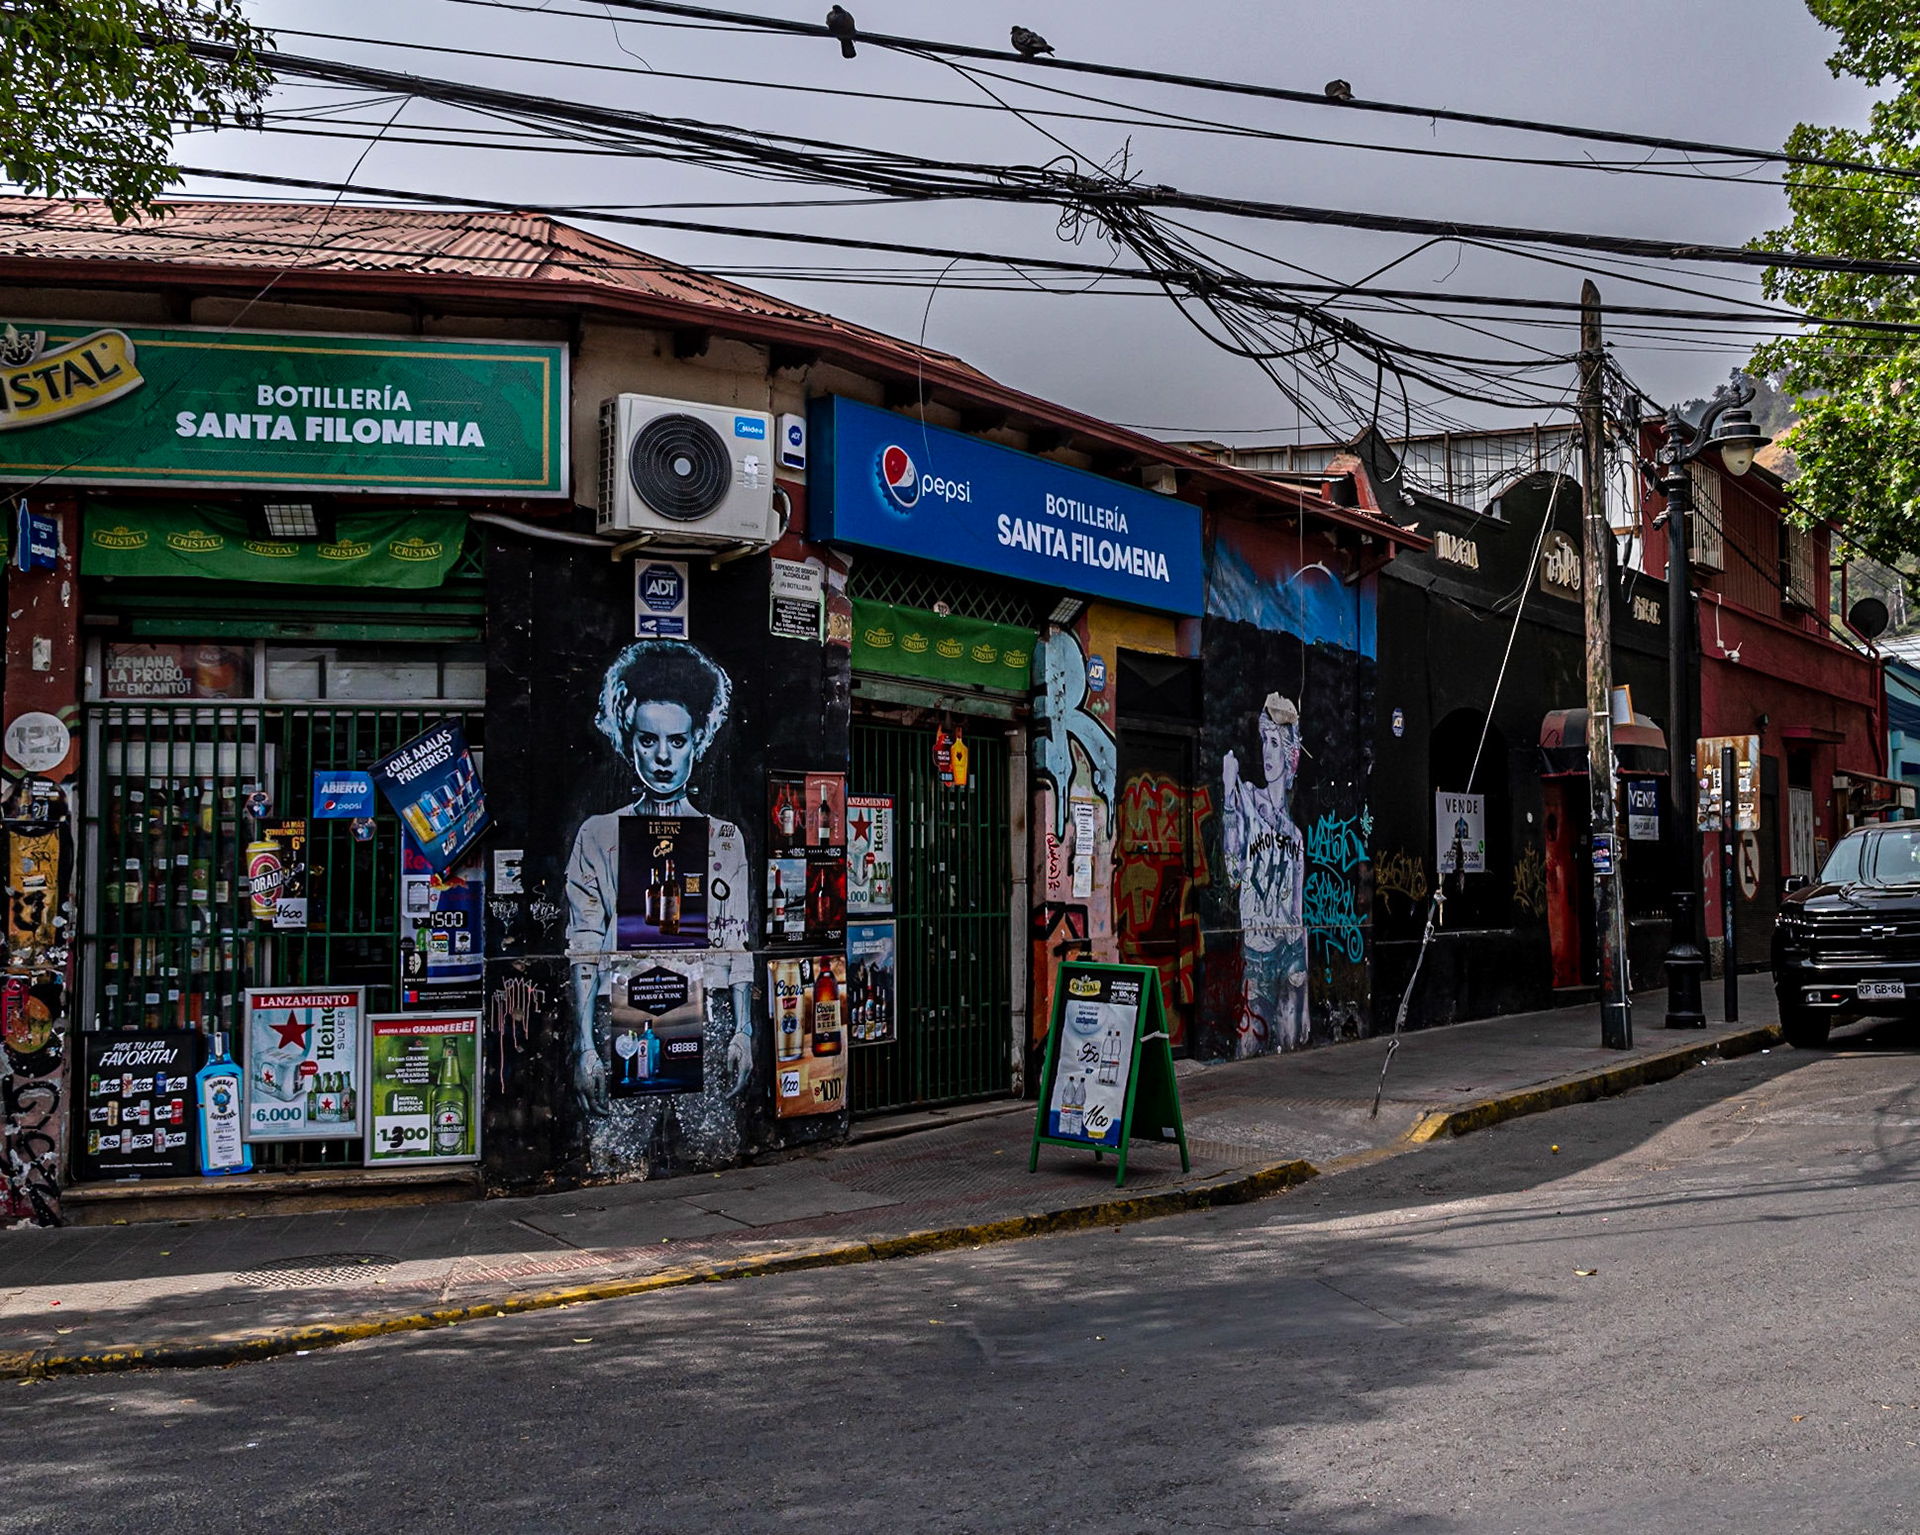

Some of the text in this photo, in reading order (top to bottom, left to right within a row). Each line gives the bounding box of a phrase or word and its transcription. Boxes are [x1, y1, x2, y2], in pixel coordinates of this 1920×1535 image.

[257, 383, 412, 412] BOTILLERÍA
[175, 411, 485, 448] SANTA FILOMENA
[921, 473, 970, 504] pepsi
[1046, 492, 1129, 535] BOTILLERÍA
[97, 534, 144, 548] CRISTAL
[172, 534, 219, 549] CRISTAL
[247, 541, 294, 555] CRISTAL
[997, 513, 1171, 583] SANTA FILOMENA
[323, 544, 368, 557] CRISTAL
[394, 544, 438, 557] CRISTAL
[646, 578, 678, 597] ADT
[866, 633, 892, 645] CRISTAL
[904, 638, 927, 649] CRISTAL
[938, 644, 961, 655] CRISTAL
[973, 650, 995, 661] CRISTAL
[1005, 655, 1027, 665] CRISTAL
[108, 669, 128, 682] LA
[1089, 664, 1105, 681] ADT
[127, 681, 192, 695] ENCANTÓ!
[385, 729, 453, 778] ¿QUÉ AAALAS
[396, 745, 454, 785] PREFIERES?
[321, 781, 367, 794] ABIERTO
[337, 800, 362, 811] pepsi
[1446, 798, 1478, 814] VENDE
[431, 911, 464, 928] 1500
[775, 980, 804, 996] Coors
[1071, 982, 1098, 992] CRISTAL
[260, 994, 350, 1007] LANZAMIENTO
[816, 1003, 836, 1013] Coors
[337, 1010, 346, 1049] SILVER
[112, 1040, 166, 1051] PIDE TU LATA
[98, 1048, 179, 1067] FAVORITA!
[814, 1077, 842, 1102] $ 1000
